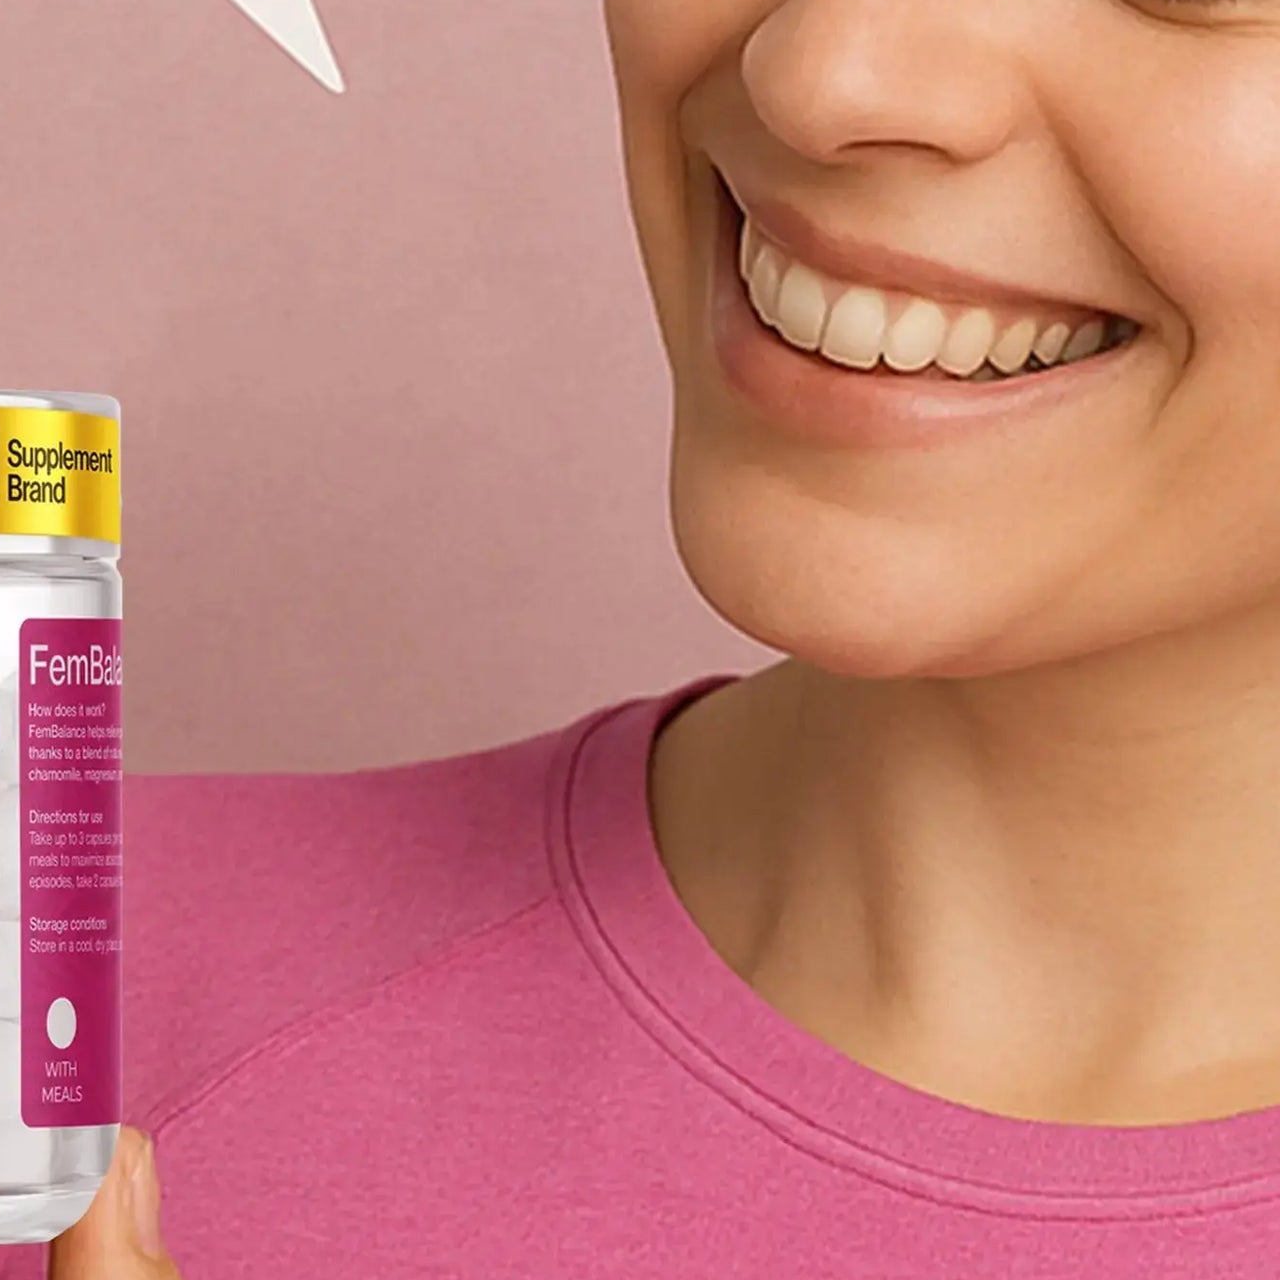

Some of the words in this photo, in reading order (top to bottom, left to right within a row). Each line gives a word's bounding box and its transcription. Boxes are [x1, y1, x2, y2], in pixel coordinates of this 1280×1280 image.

[7, 438, 113, 474] Supplement
[7, 473, 66, 504] Brand
[28, 702, 52, 717] How
[54, 703, 77, 718] does
[28, 724, 86, 739] FemBalance
[28, 746, 63, 760] thanks
[64, 747, 74, 760] to
[75, 750, 81, 760] a
[28, 767, 83, 783] chamomile,
[29, 809, 78, 824] Directions
[79, 809, 90, 824] for
[91, 812, 103, 823] use
[28, 831, 53, 845] Take
[55, 834, 67, 848] up
[68, 832, 78, 845] to
[29, 853, 59, 867] meals
[60, 853, 70, 867] to
[29, 874, 75, 890] episodes,
[29, 916, 68, 934] Storage
[29, 938, 57, 953] Store
[45, 1061, 78, 1078] WITH
[41, 1085, 83, 1102] MEALS
